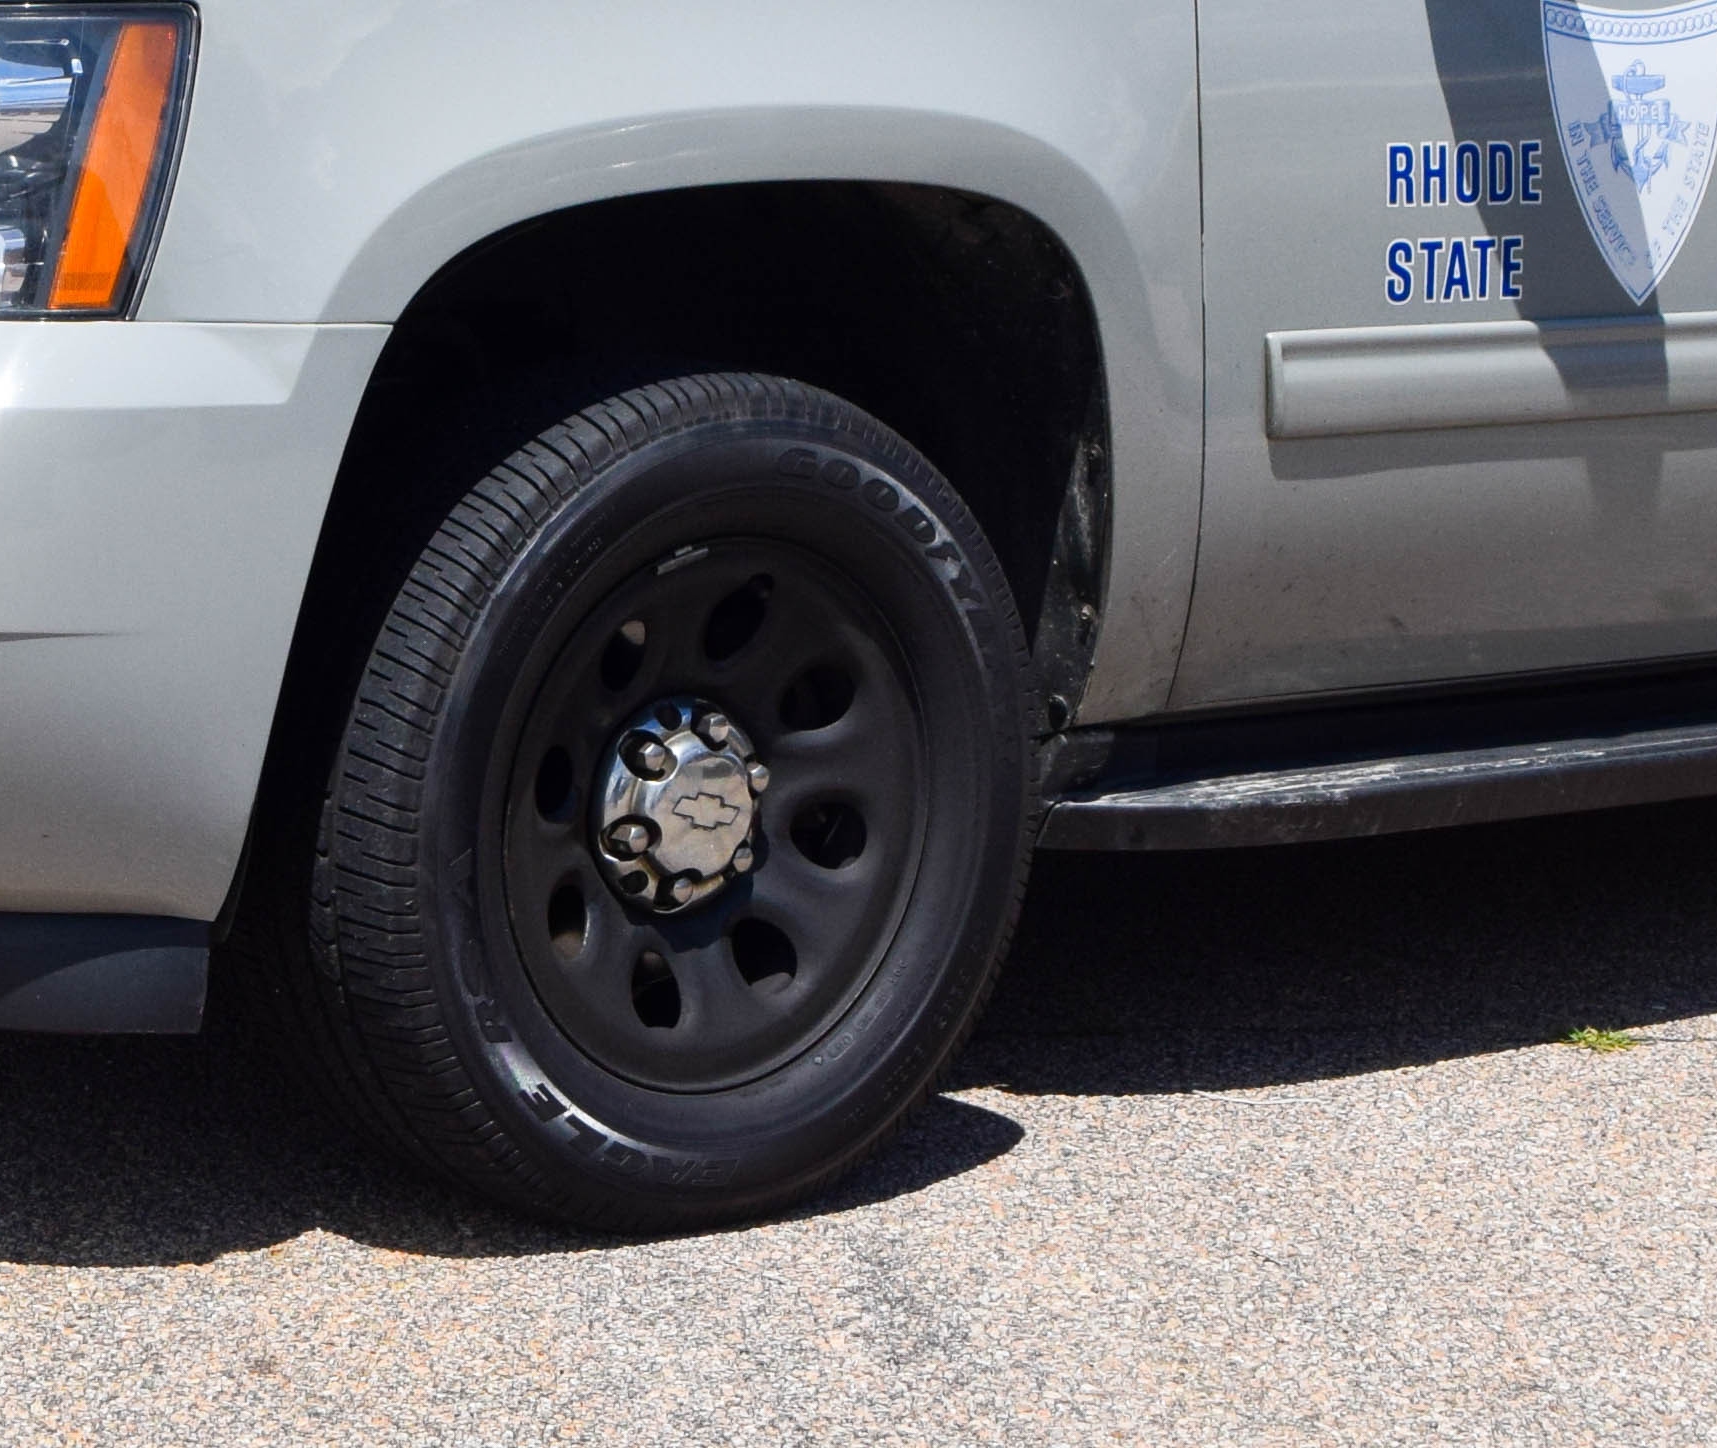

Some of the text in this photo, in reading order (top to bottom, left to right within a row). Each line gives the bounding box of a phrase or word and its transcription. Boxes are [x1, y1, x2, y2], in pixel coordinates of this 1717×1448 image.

[1618, 104, 1661, 120] HOPE
[1386, 139, 1542, 207] RHODE
[1385, 235, 1524, 305] STATE
[520, 1083, 740, 1187] EAGLE
